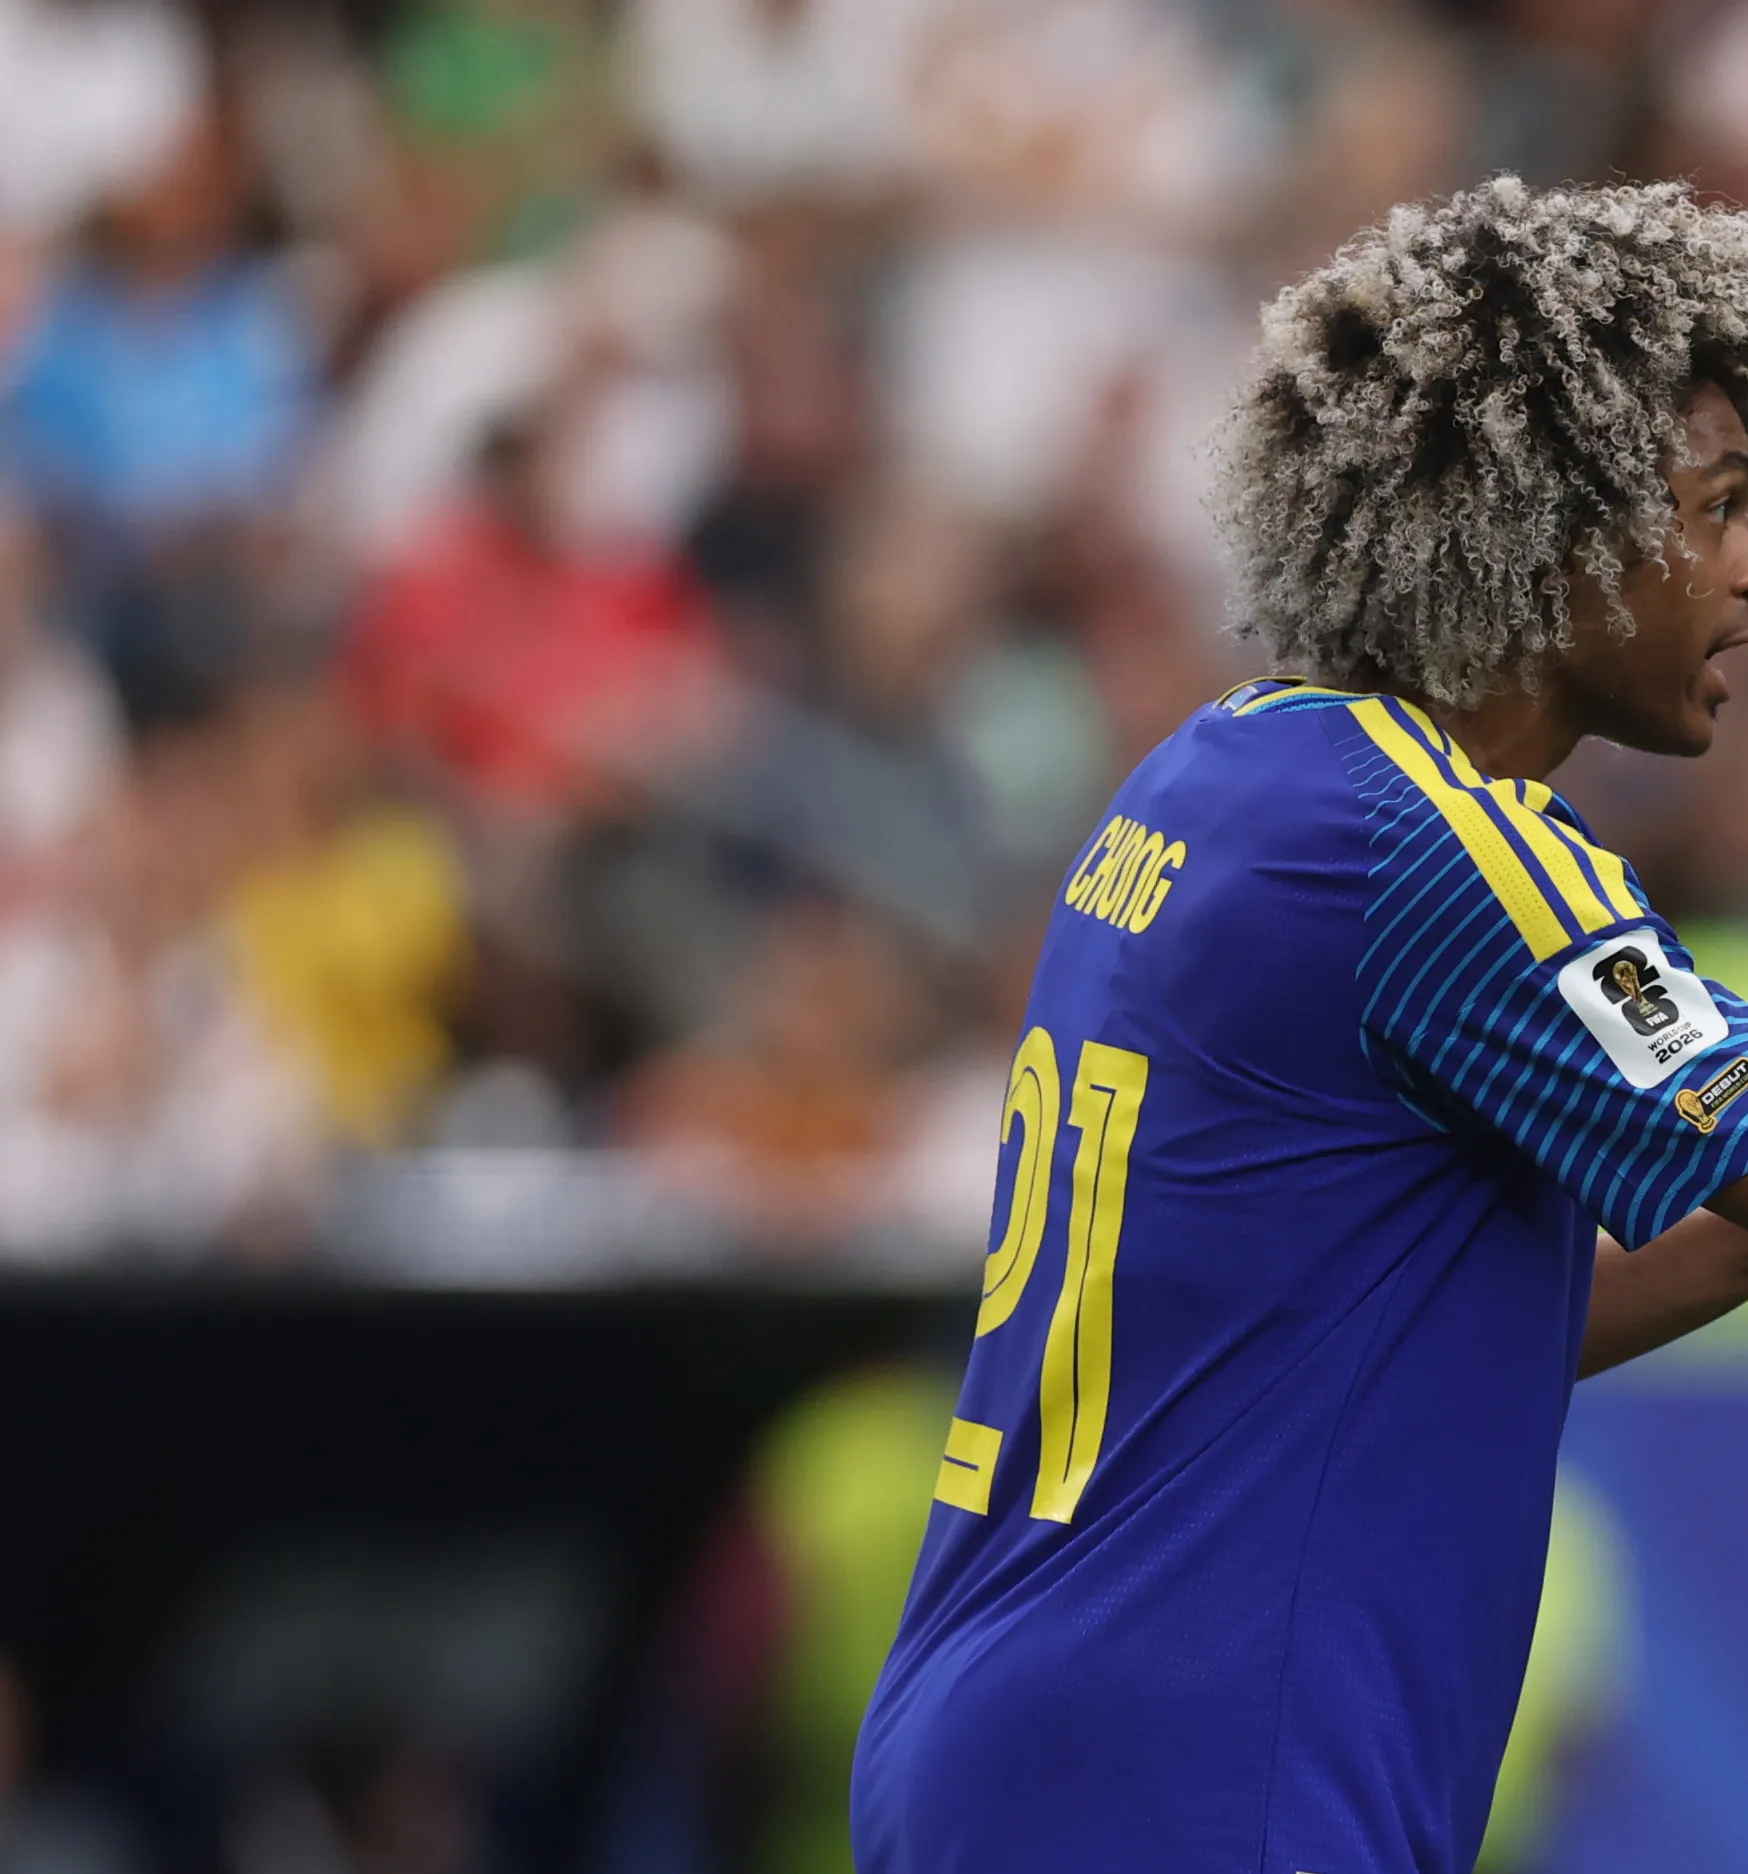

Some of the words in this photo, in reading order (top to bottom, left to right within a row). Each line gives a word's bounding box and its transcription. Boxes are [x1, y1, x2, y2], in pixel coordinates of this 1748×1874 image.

[1065, 815, 1188, 935] CHONG
[1647, 1027, 1679, 1052] WORLD
[1655, 1029, 1704, 1065] 2026
[1700, 1062, 1748, 1105] DEBUT
